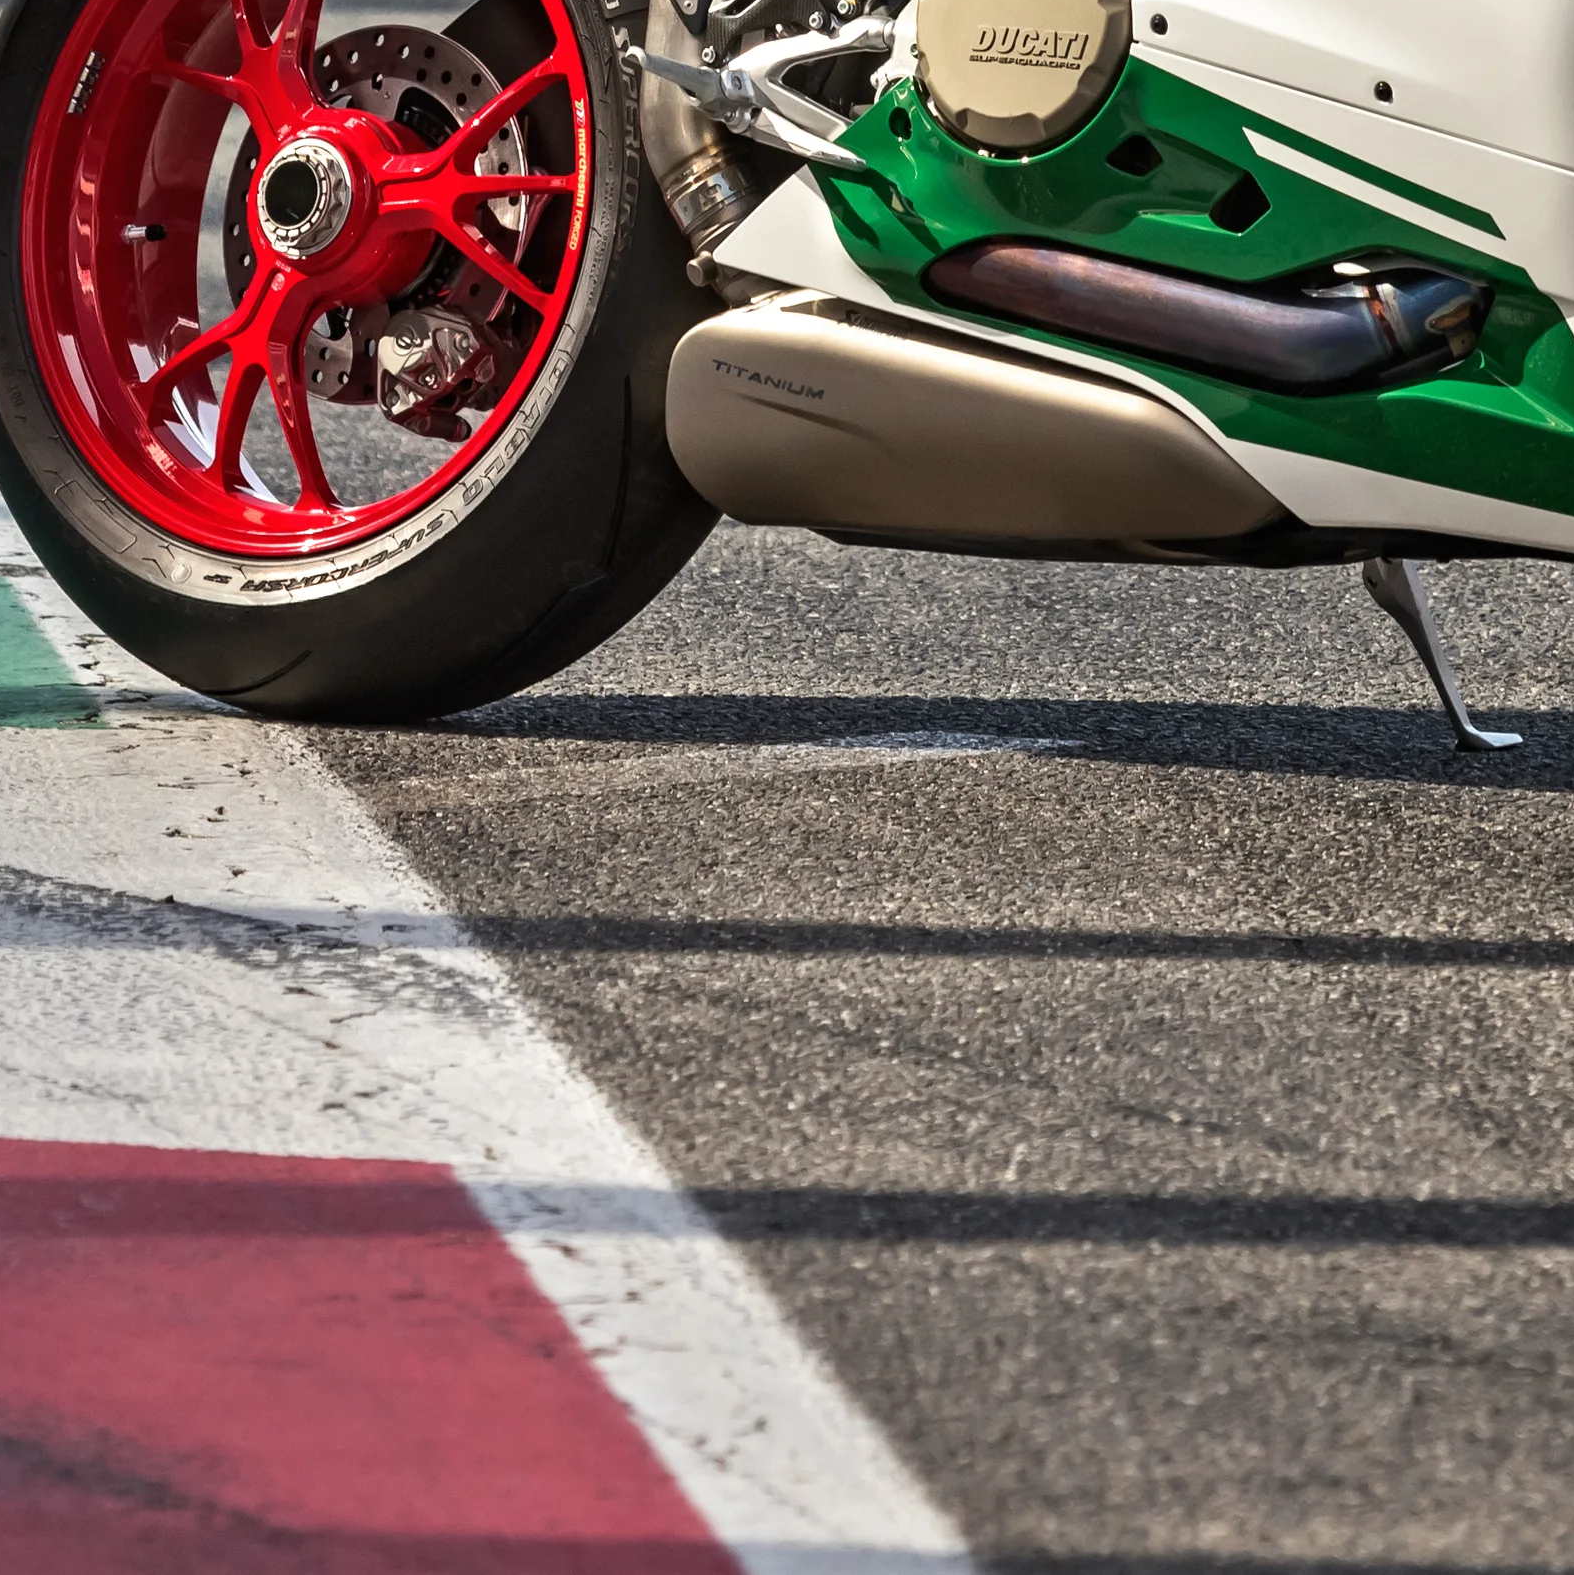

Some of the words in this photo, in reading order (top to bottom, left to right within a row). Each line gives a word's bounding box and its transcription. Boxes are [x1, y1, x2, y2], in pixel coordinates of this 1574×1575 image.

[971, 24, 1090, 61] DUCATI
[569, 208, 582, 251] FORGED
[712, 358, 825, 401] TITANIUM
[462, 357, 570, 506] DIABLO
[239, 510, 445, 592] SUPERCORSA
